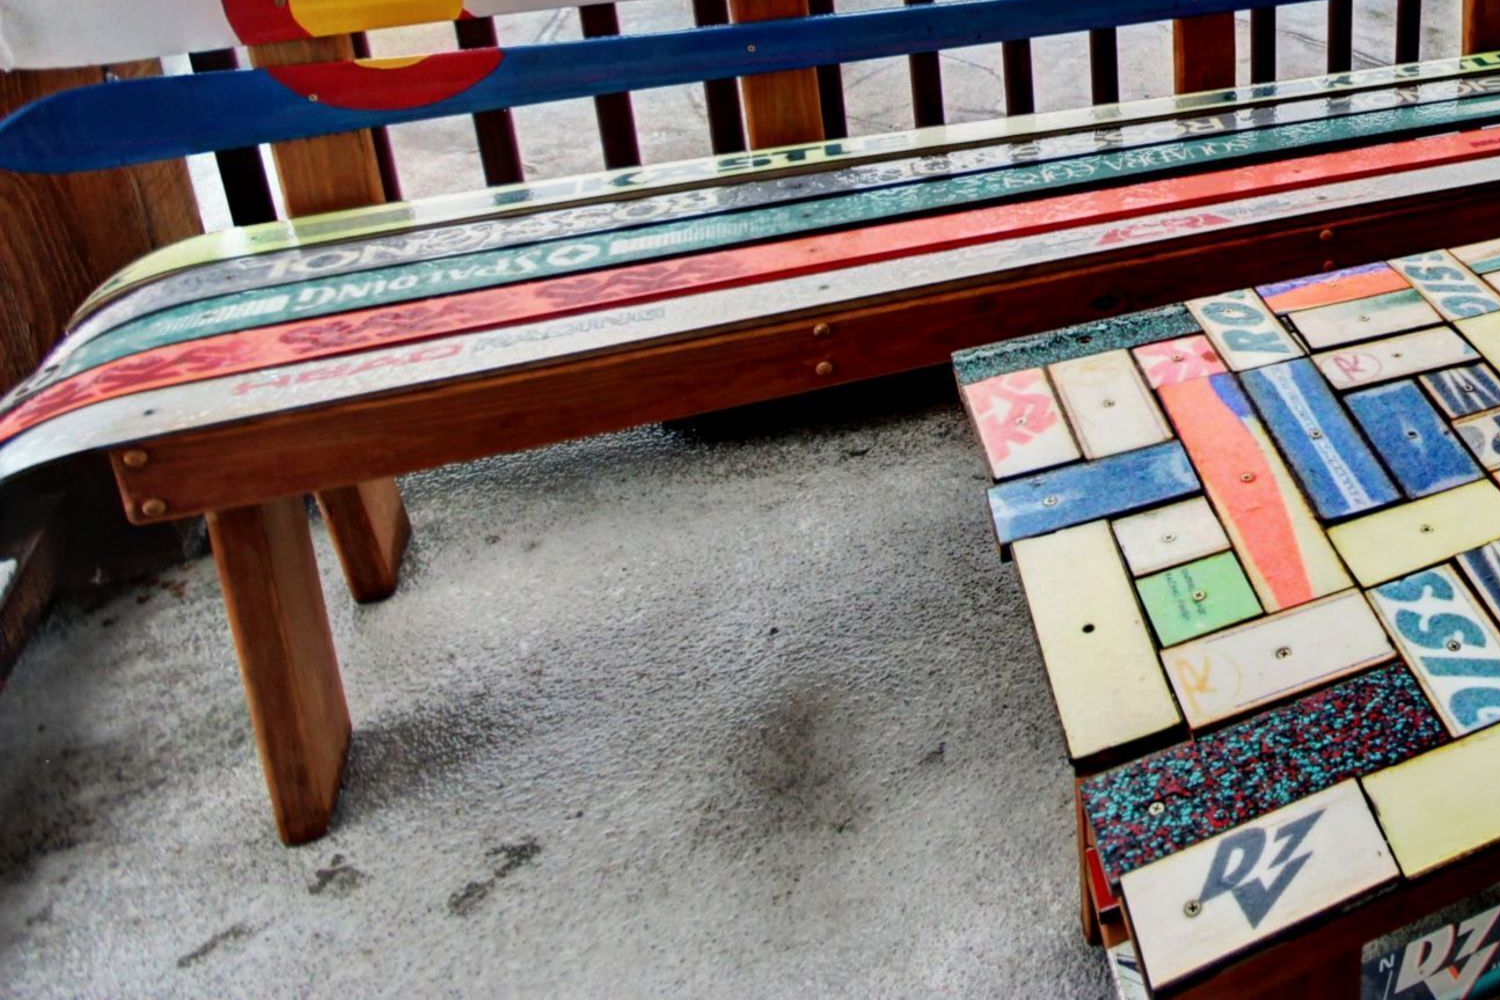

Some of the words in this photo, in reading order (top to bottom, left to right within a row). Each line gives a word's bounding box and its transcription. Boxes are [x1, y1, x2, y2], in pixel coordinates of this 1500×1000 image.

[239, 187, 716, 280] ROSSIGNOL
[294, 249, 544, 312] SPALDING
[1201, 289, 1293, 356] RO
[234, 343, 463, 396] HEAD
